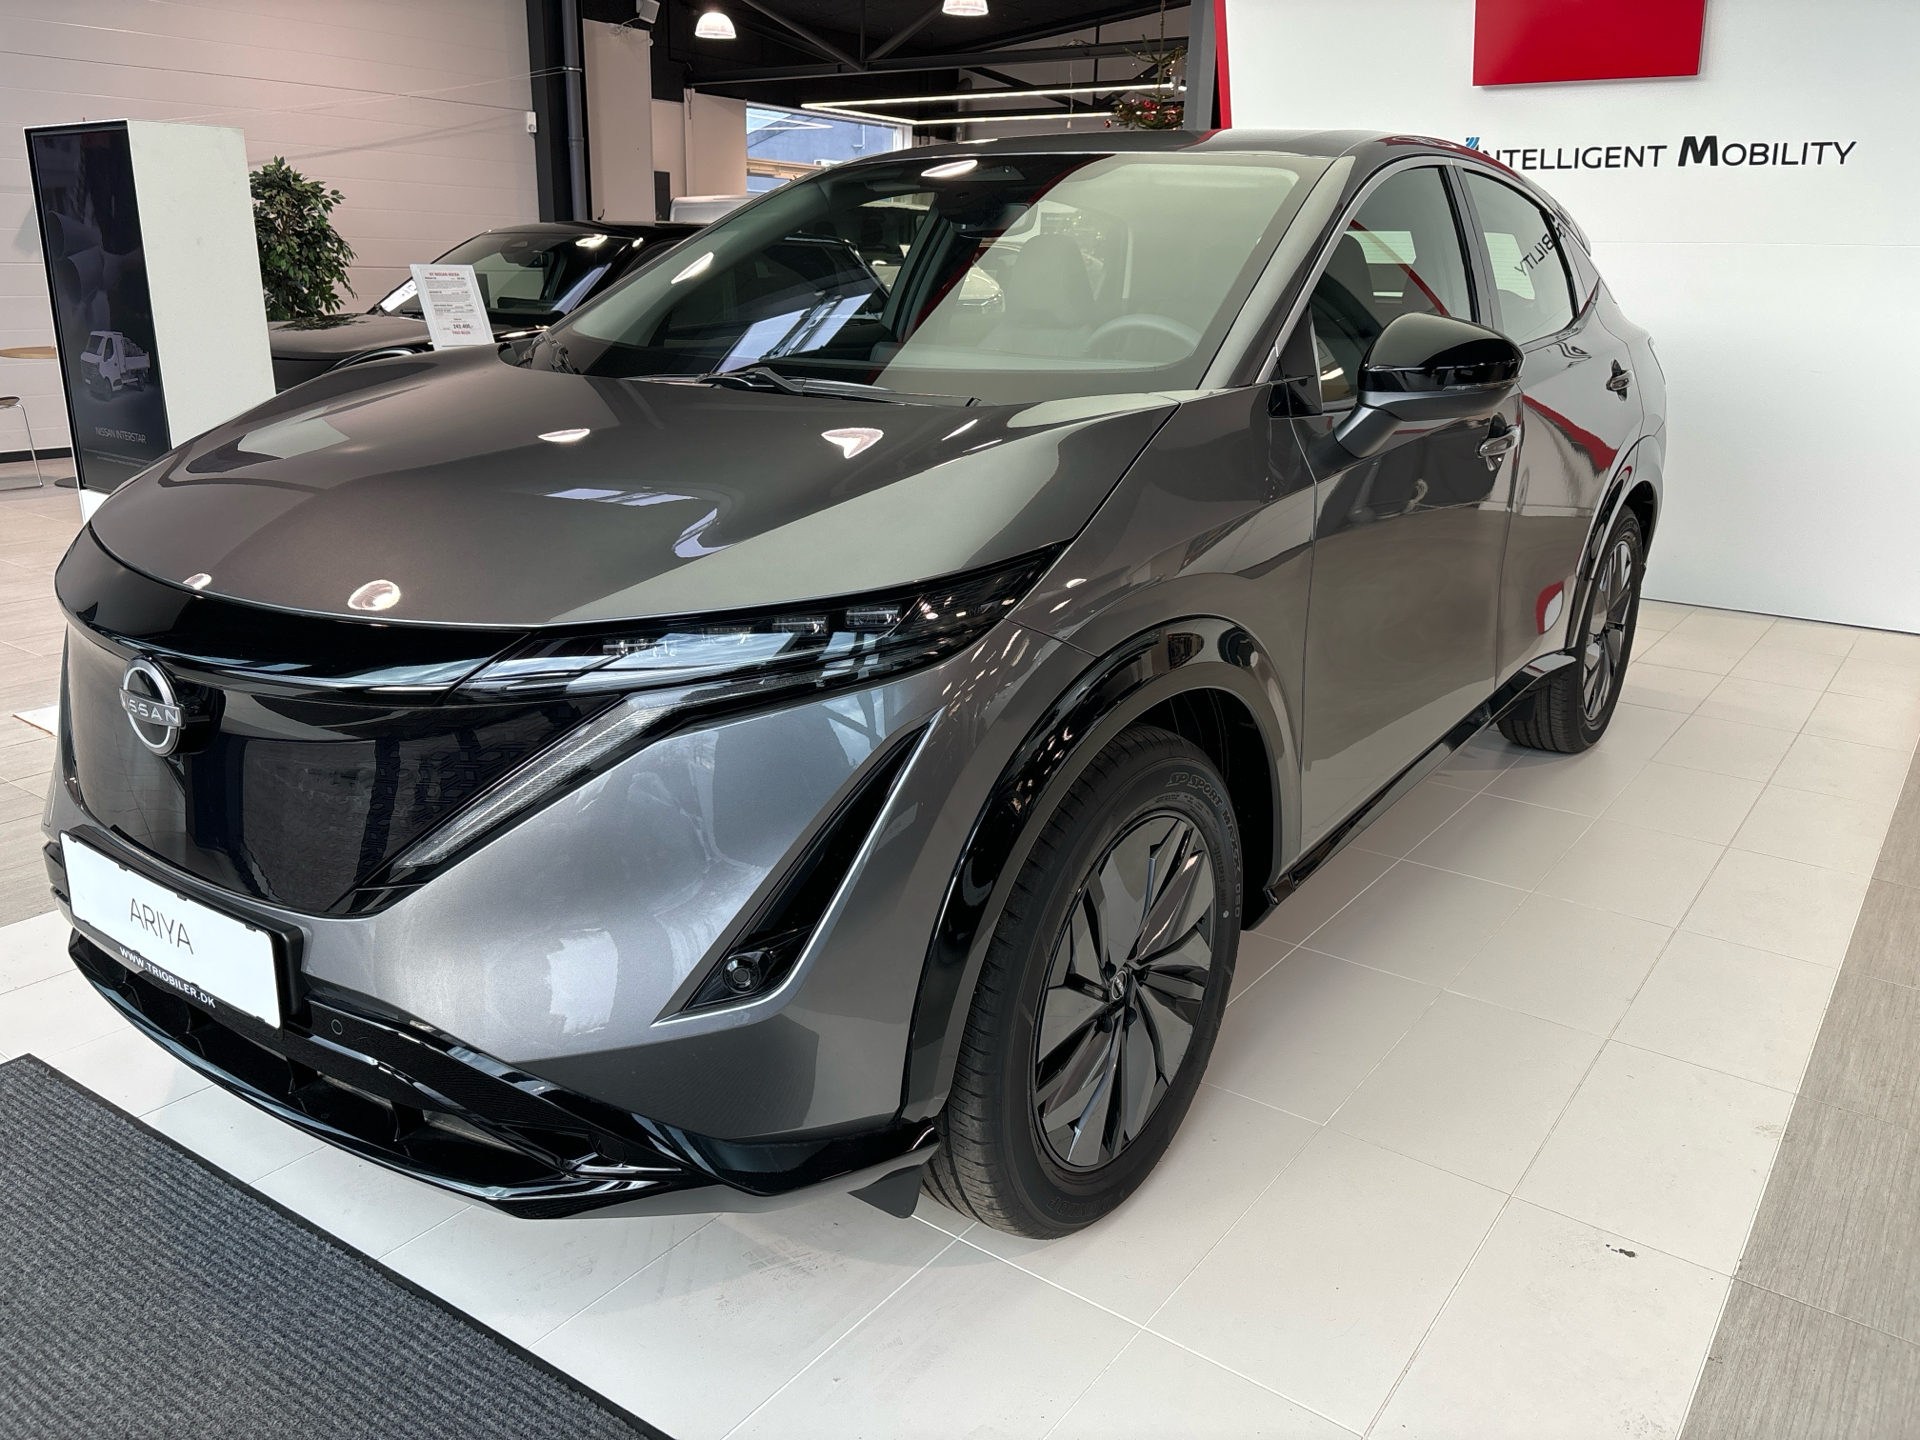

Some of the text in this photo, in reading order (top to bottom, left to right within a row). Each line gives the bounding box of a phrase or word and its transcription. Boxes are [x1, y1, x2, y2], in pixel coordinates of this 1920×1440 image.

[1678, 135, 1857, 167] MOBILITY
[95, 426, 147, 444] NISSAN INTERSTAR
[119, 691, 179, 725] NISSAN
[1166, 772, 1189, 788] SP
[1187, 773, 1224, 807] SPORT
[129, 897, 194, 955] ARIYA
[119, 946, 216, 1008] WWW.TRIOBILER.DK
[1046, 1193, 1113, 1218] DUNLOP
